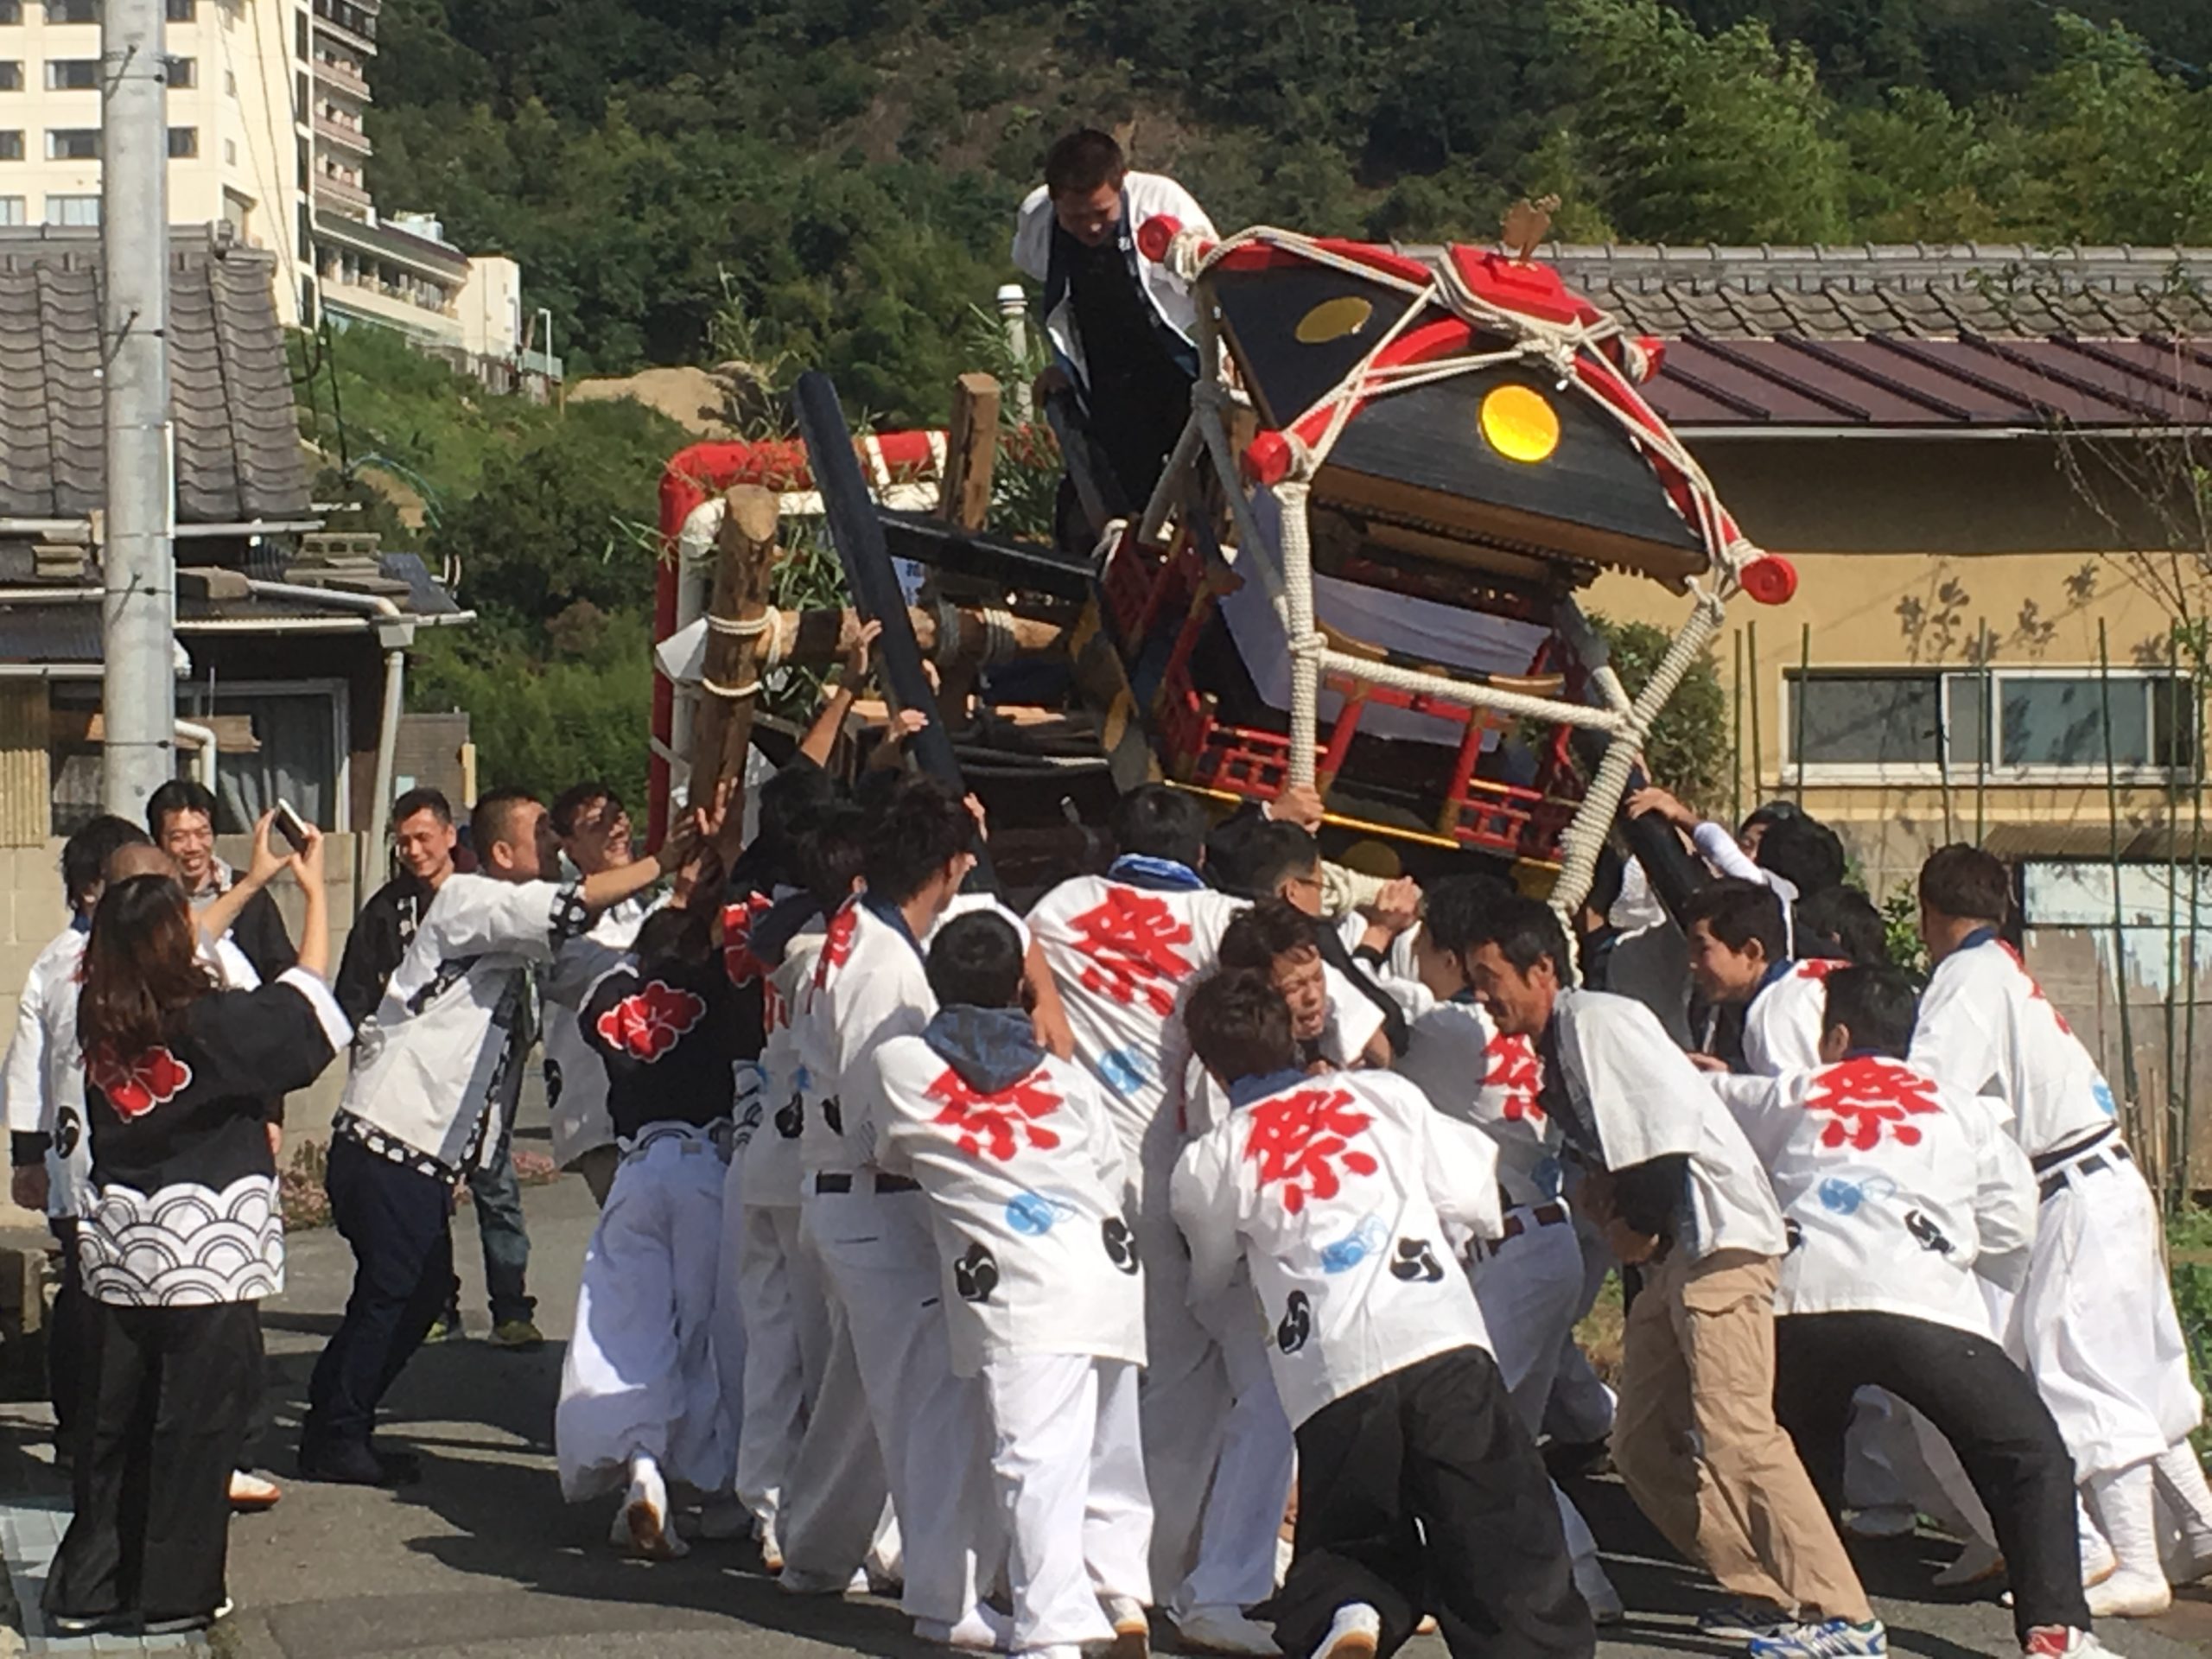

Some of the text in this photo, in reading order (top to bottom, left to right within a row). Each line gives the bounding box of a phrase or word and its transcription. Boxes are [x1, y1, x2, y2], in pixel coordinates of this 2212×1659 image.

[1068, 887, 1194, 1017] 祭
[925, 1068, 1063, 1161] 祭
[1243, 1089, 1378, 1214] 祭
[1804, 1055, 1942, 1152] 祭
